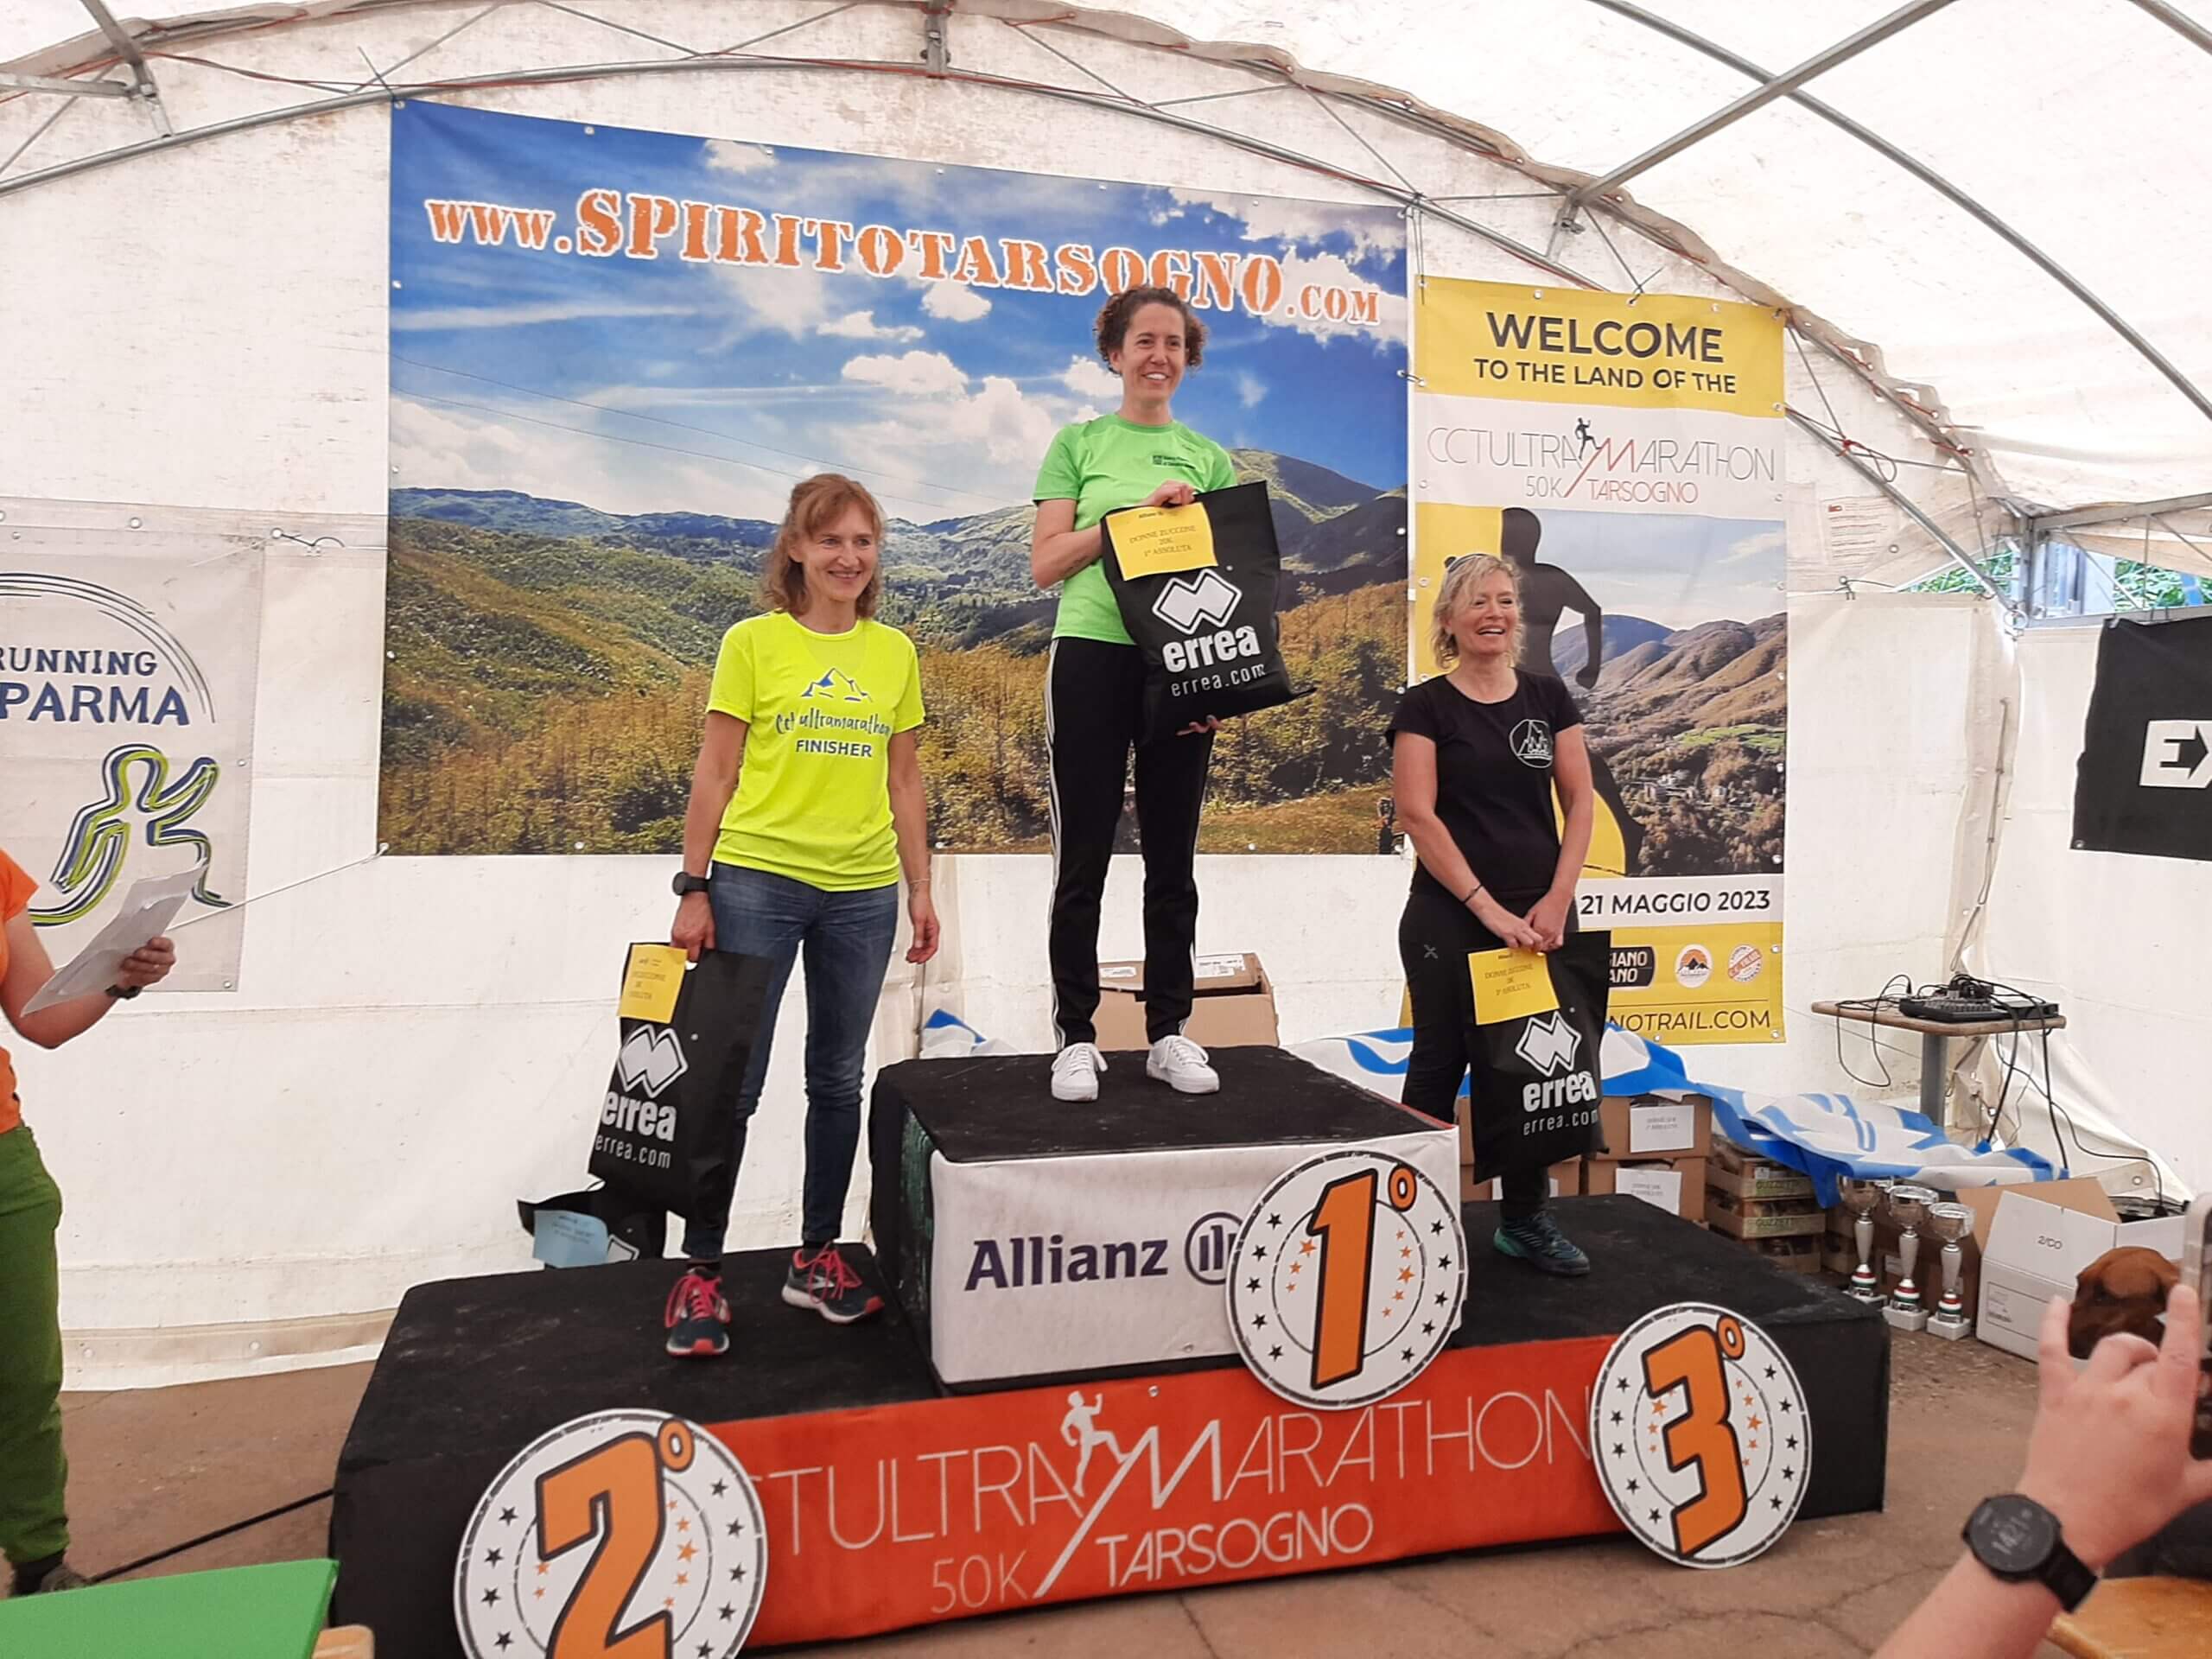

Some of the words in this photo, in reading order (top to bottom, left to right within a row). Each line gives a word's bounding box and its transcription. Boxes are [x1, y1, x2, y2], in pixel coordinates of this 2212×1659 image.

[1485, 311, 1725, 364] WELCOME
[1473, 359, 1509, 380] TO
[1516, 361, 1566, 385] THE
[1574, 365, 1643, 389] LAND
[1652, 368, 1685, 390] OF
[1692, 372, 1737, 394] THE
[1525, 474, 1563, 498] 50K
[1586, 477, 1700, 504] TARSOGNO
[1171, 663, 1267, 697] errea.com
[0, 681, 190, 726] PARMA
[795, 739, 874, 758] FINISHER
[1580, 894, 1604, 915] 21
[1611, 893, 1712, 915] MAGGIO
[1718, 889, 1770, 911] 2023
[1610, 950, 1648, 967] IANO
[594, 1132, 671, 1169] errea.com
[964, 1233, 1169, 1292] Allianz
[931, 1549, 1030, 1615] 50K
[1096, 1502, 1374, 1588] TARSOGNO
